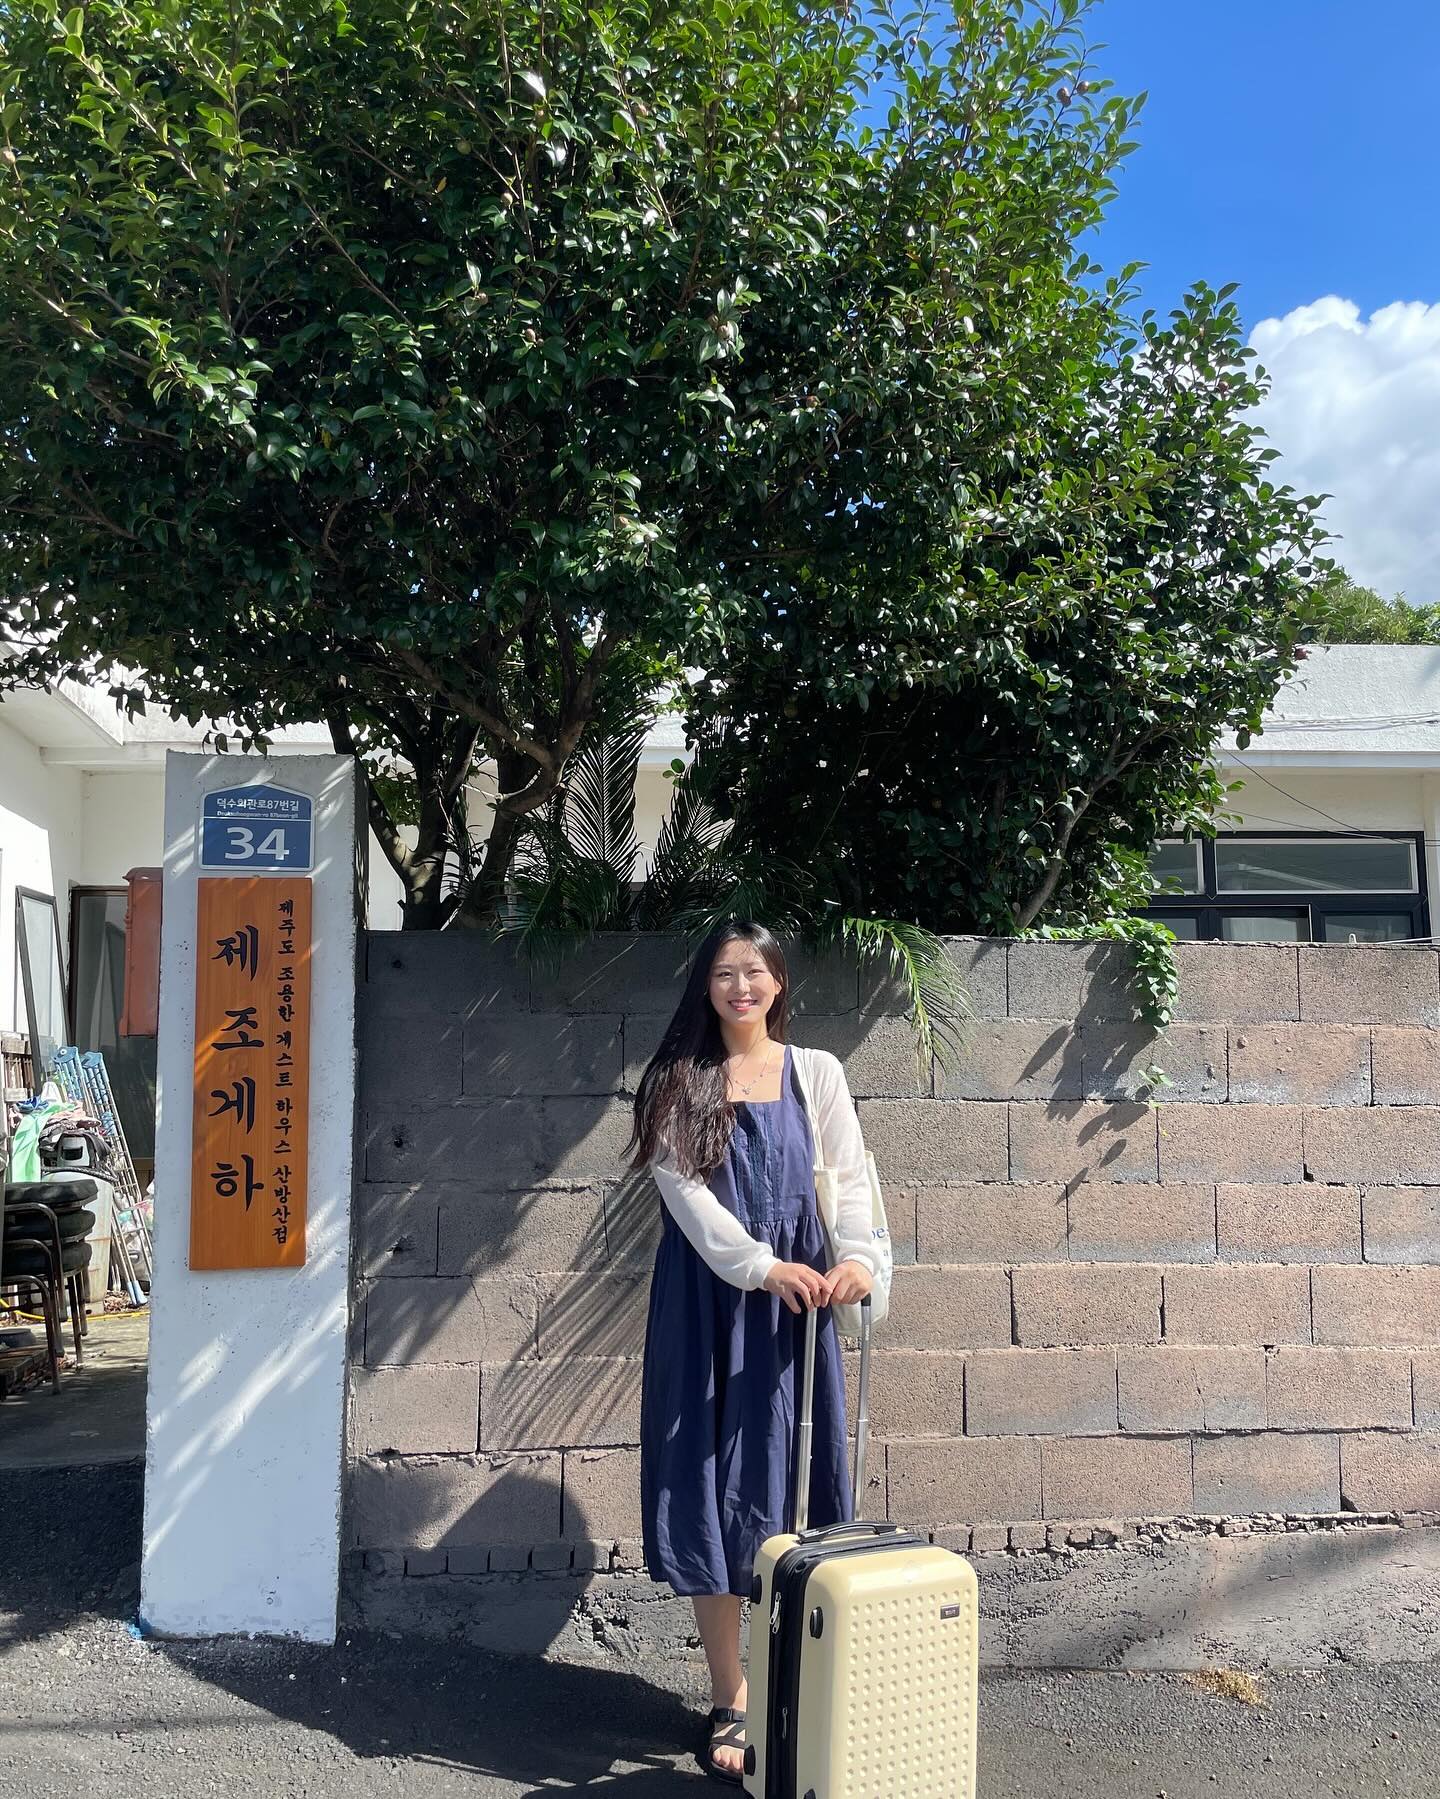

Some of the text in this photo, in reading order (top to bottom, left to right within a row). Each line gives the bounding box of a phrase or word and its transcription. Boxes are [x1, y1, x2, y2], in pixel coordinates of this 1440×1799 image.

[217, 798, 299, 811] 덕수회관로87번길
[224, 826, 290, 861] 34
[208, 924, 265, 1213] 제조게하
[271, 899, 296, 1244] 제주도 조용한 게스트 하우스 산방산점
